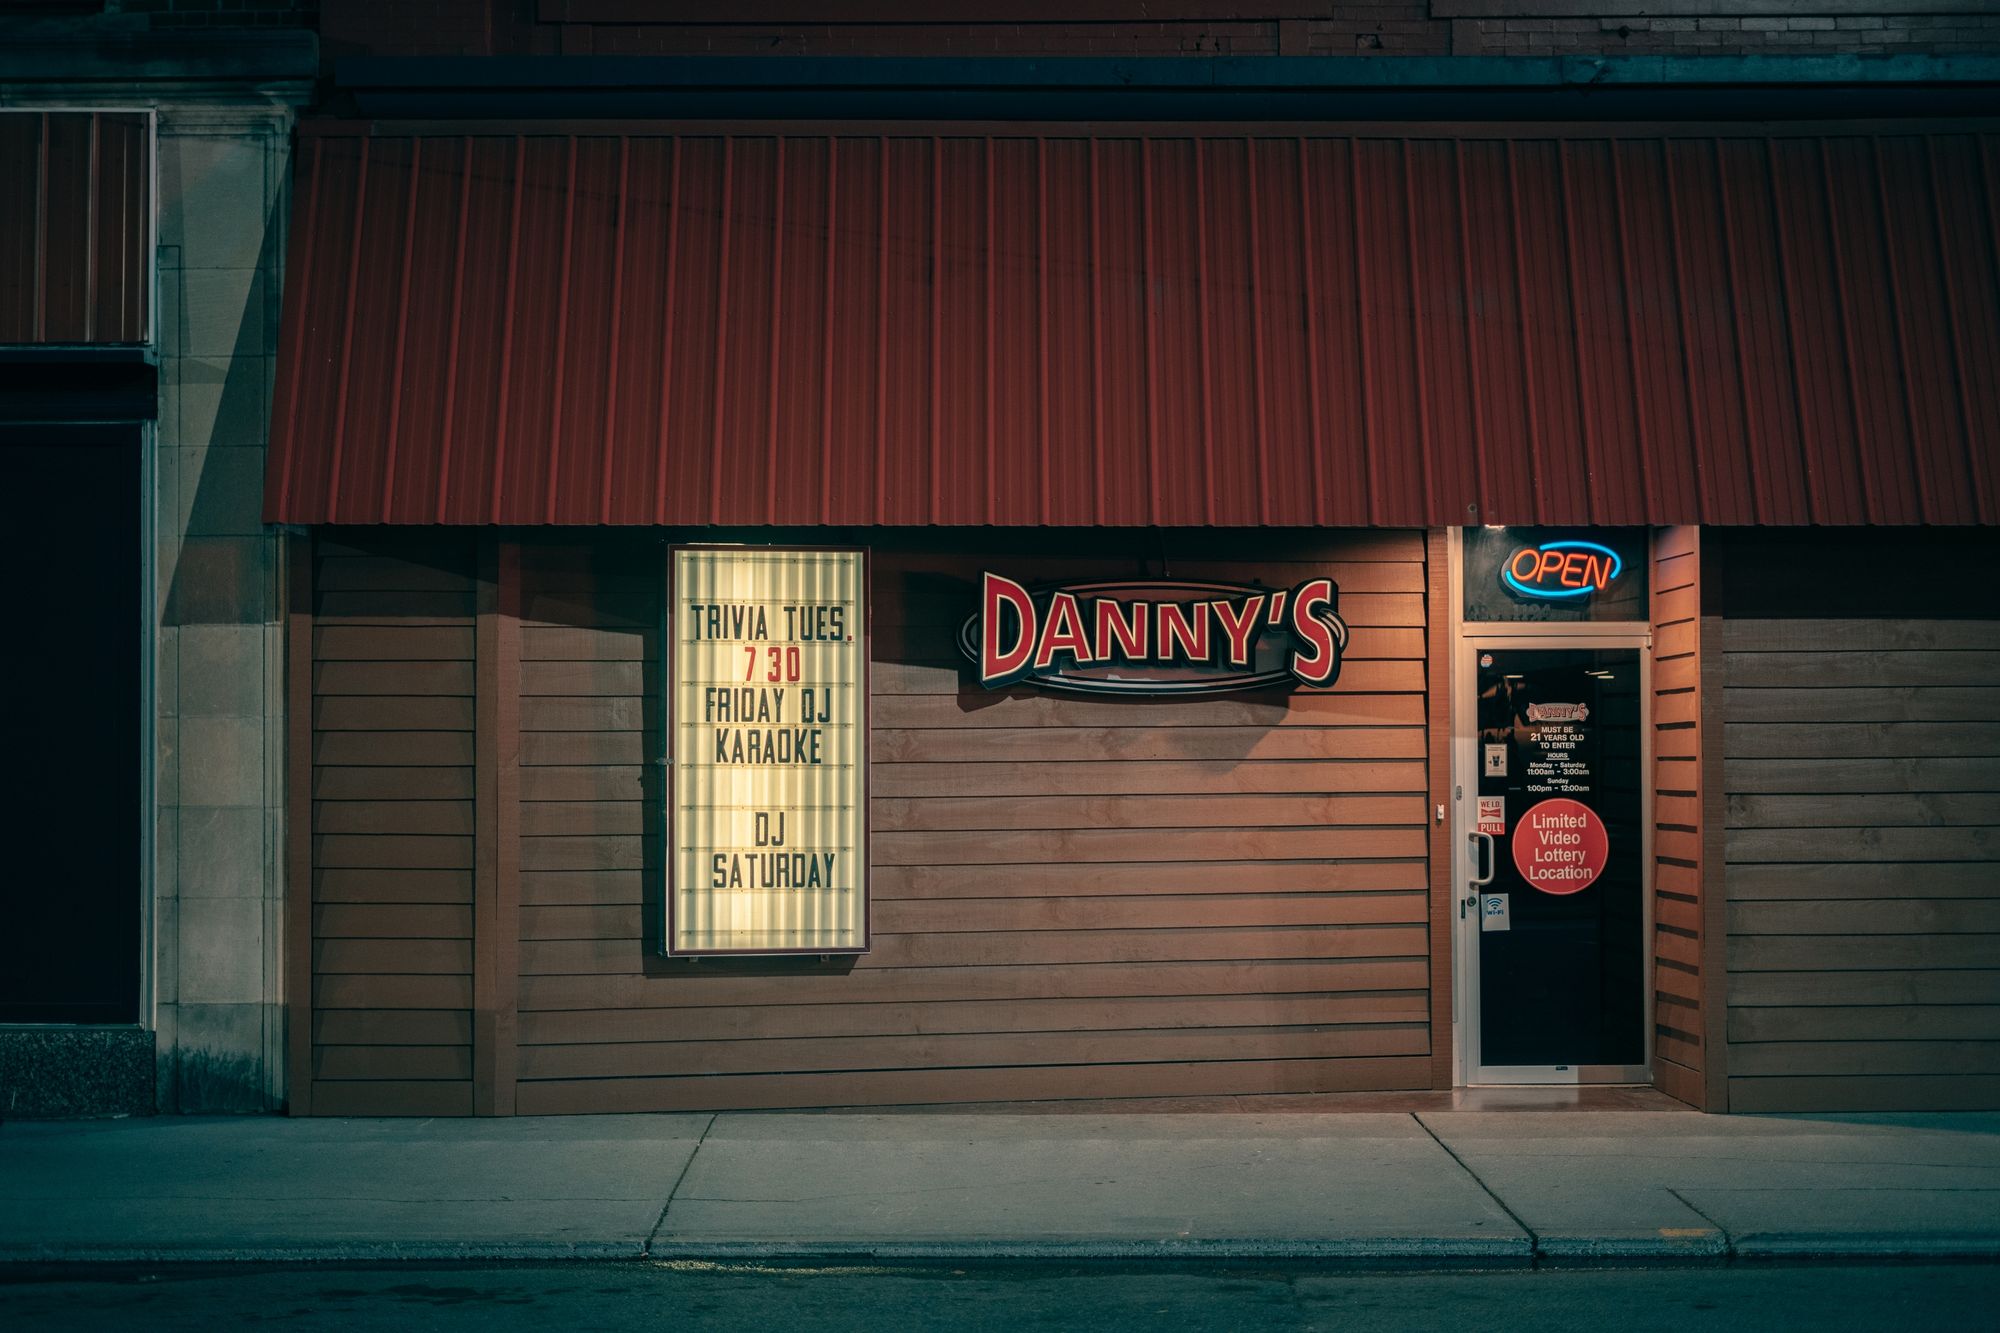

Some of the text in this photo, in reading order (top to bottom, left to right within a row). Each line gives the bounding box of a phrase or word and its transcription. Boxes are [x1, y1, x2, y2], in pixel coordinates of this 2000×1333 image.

[1511, 548, 1612, 590] OPEN
[691, 604, 852, 641] TRIVIA TUES.
[981, 570, 1334, 685] DANNY'S
[705, 687, 831, 723] FRIDAY DJ
[1528, 702, 1586, 722] DANNY'S
[716, 728, 822, 764] KARAOKE
[1530, 733, 1541, 742] 21
[1480, 800, 1490, 808] WE
[755, 811, 785, 847] DJ
[1480, 823, 1502, 832] PULL
[1532, 813, 1587, 829] Limited
[1539, 830, 1581, 845] Video
[1535, 847, 1586, 864] Lottery
[713, 853, 835, 889] SATURDAY
[1529, 865, 1593, 880] Location
